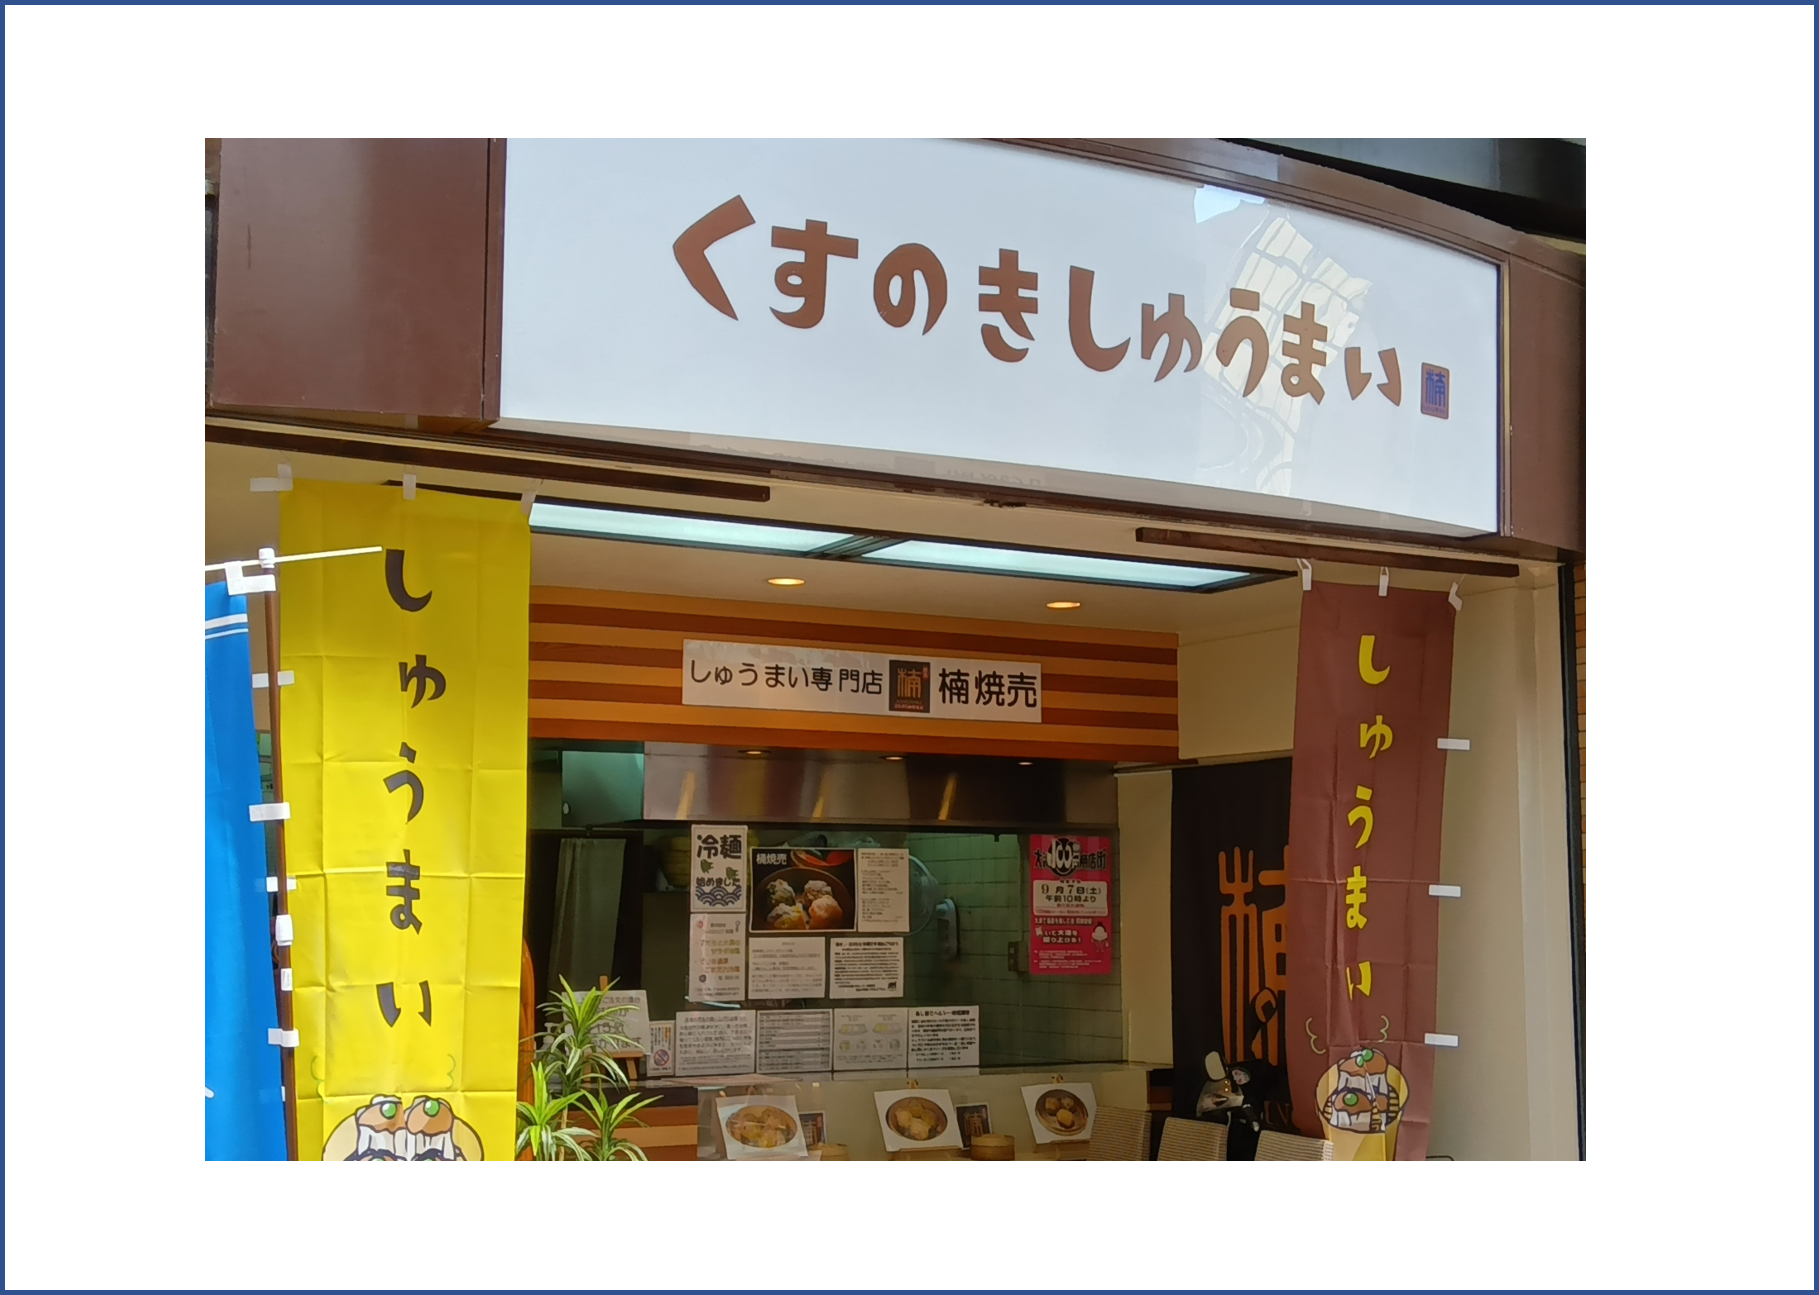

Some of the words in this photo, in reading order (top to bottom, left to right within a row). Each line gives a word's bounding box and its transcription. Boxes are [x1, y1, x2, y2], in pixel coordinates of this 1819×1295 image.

[673, 194, 1401, 406] くすのきしゅうまい
[376, 548, 446, 1028] しゅうまい
[689, 658, 884, 695] しゅうまい専門店
[938, 667, 1037, 709] 楠焼売
[696, 833, 742, 860] 冷麺
[1345, 634, 1394, 1001] しゅうまい
